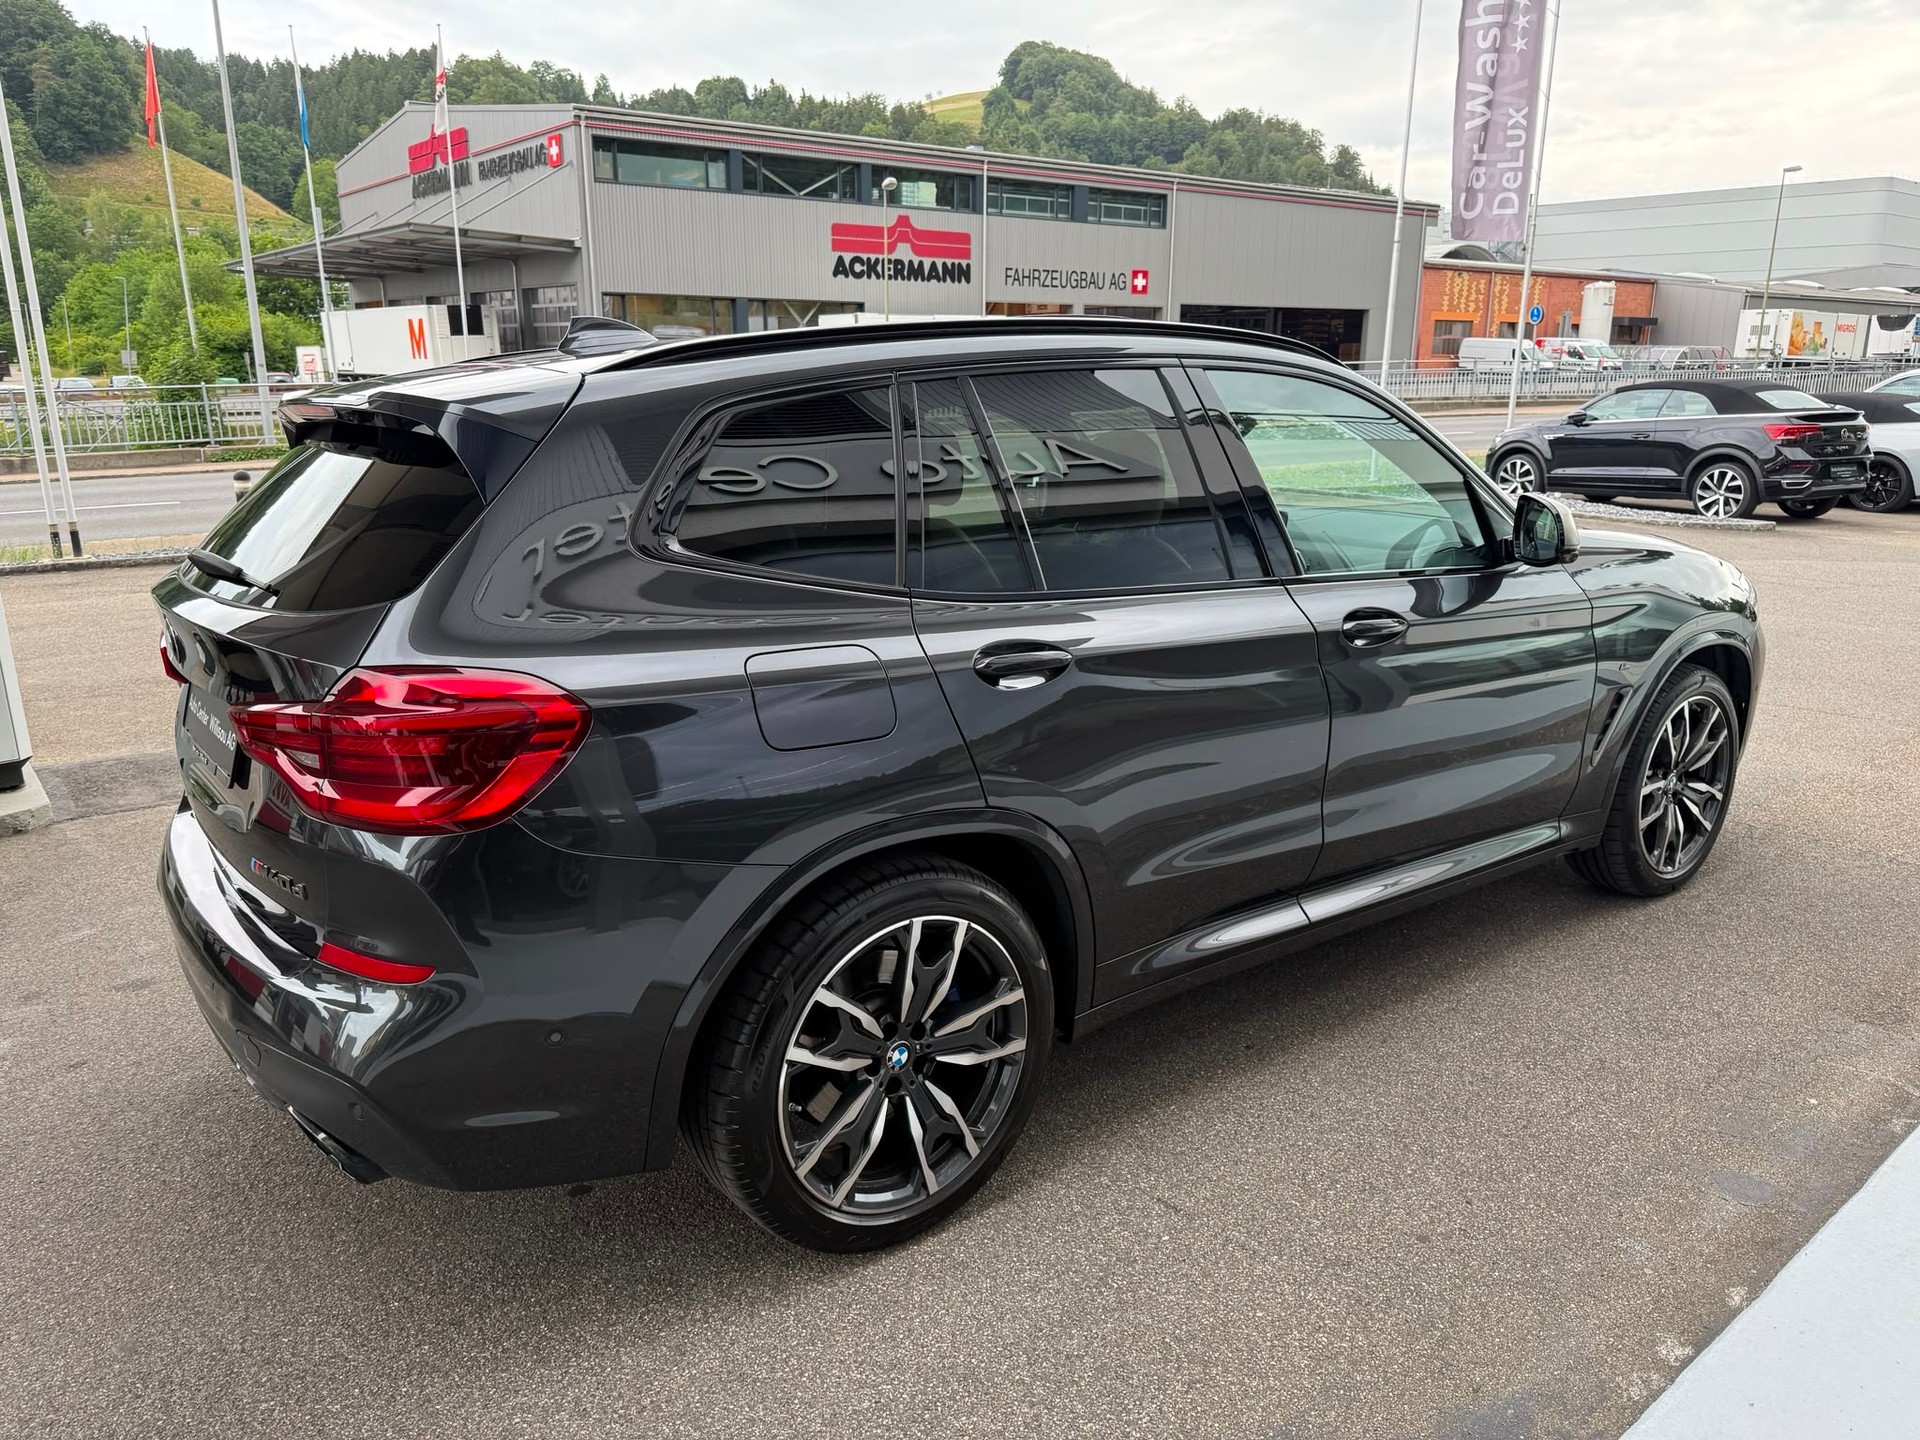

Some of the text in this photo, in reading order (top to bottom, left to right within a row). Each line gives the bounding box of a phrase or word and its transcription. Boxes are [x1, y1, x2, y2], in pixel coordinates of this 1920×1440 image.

[1492, 106, 1529, 215] DeLux
[412, 160, 472, 199] ACKERMNN
[832, 254, 971, 285] ACKERMANN
[1004, 267, 1127, 291] FAHRZEUGBAU AG
[408, 318, 429, 360] M
[1836, 323, 1857, 334] MIGROS
[225, 730, 237, 752] AG
